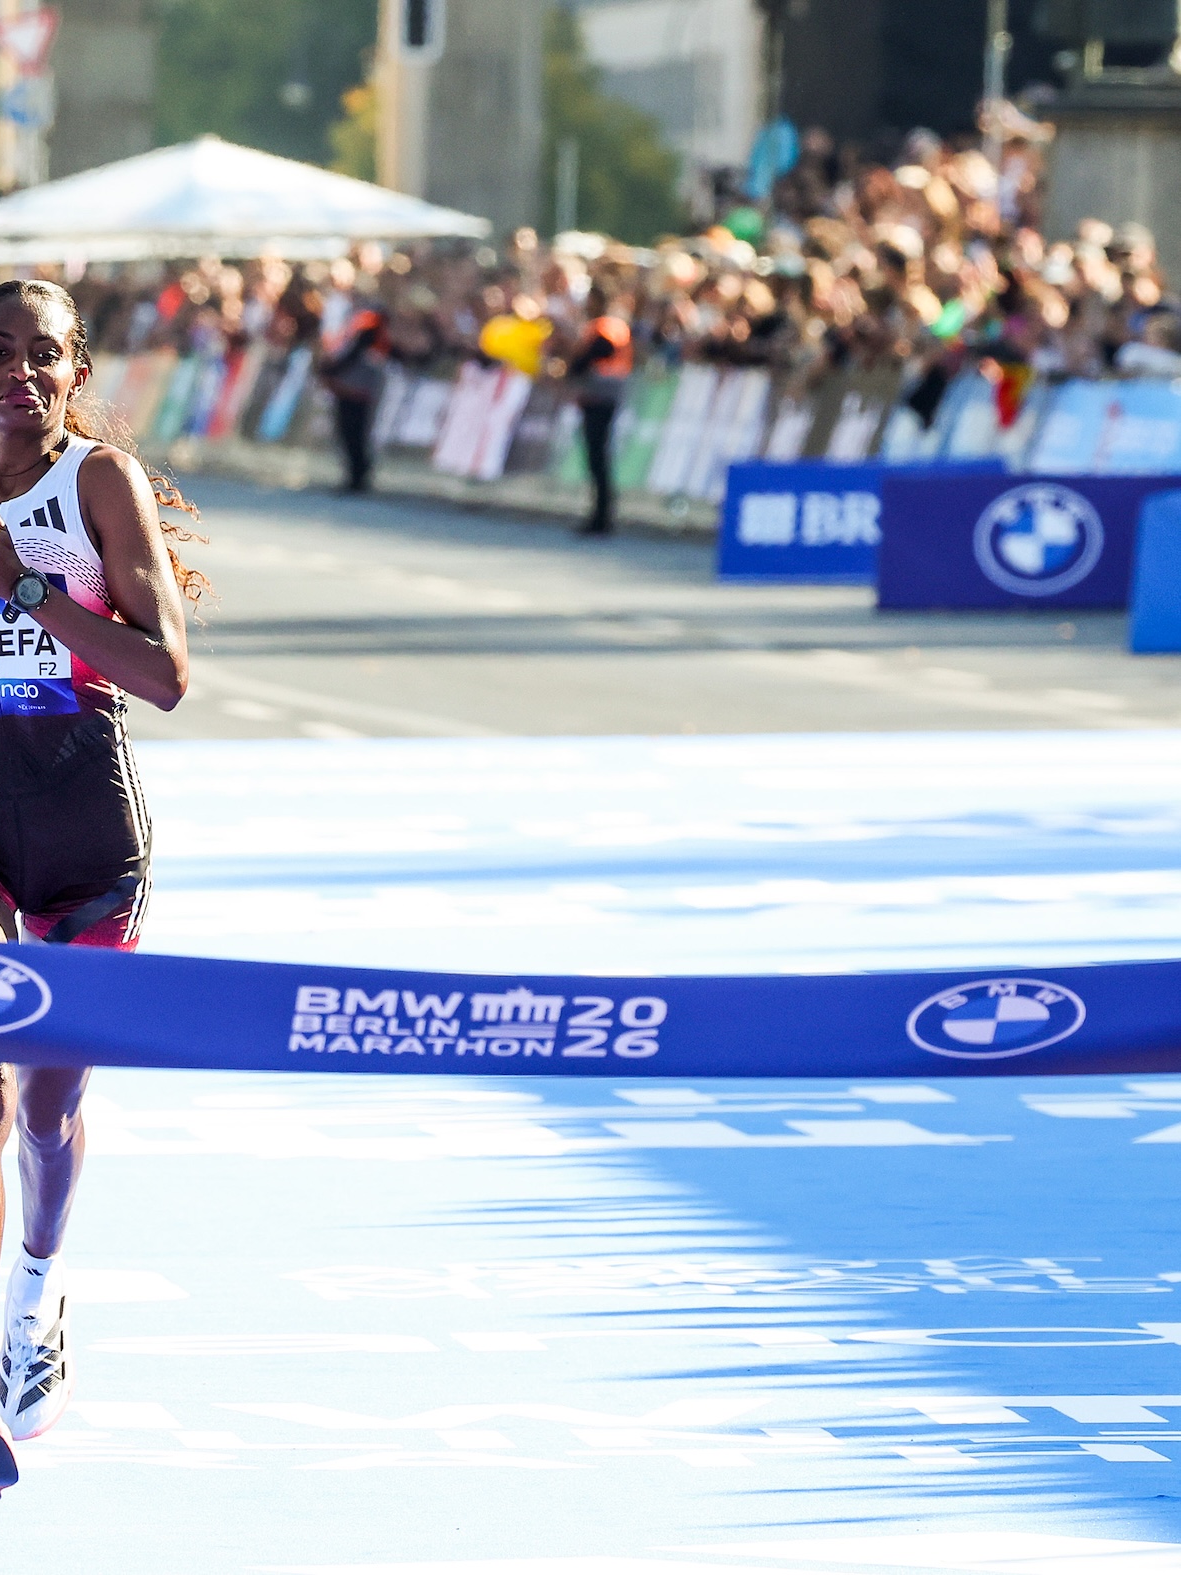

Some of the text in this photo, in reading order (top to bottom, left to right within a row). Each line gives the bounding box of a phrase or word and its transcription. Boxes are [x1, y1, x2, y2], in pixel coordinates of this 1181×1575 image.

[39, 662, 57, 676] F2
[295, 985, 464, 1019] BMW
[937, 984, 1065, 1010] BMW
[567, 996, 668, 1028] 20
[291, 1014, 460, 1037] BERLIN
[288, 1033, 555, 1058] MARATHON
[561, 1027, 660, 1059] 26
